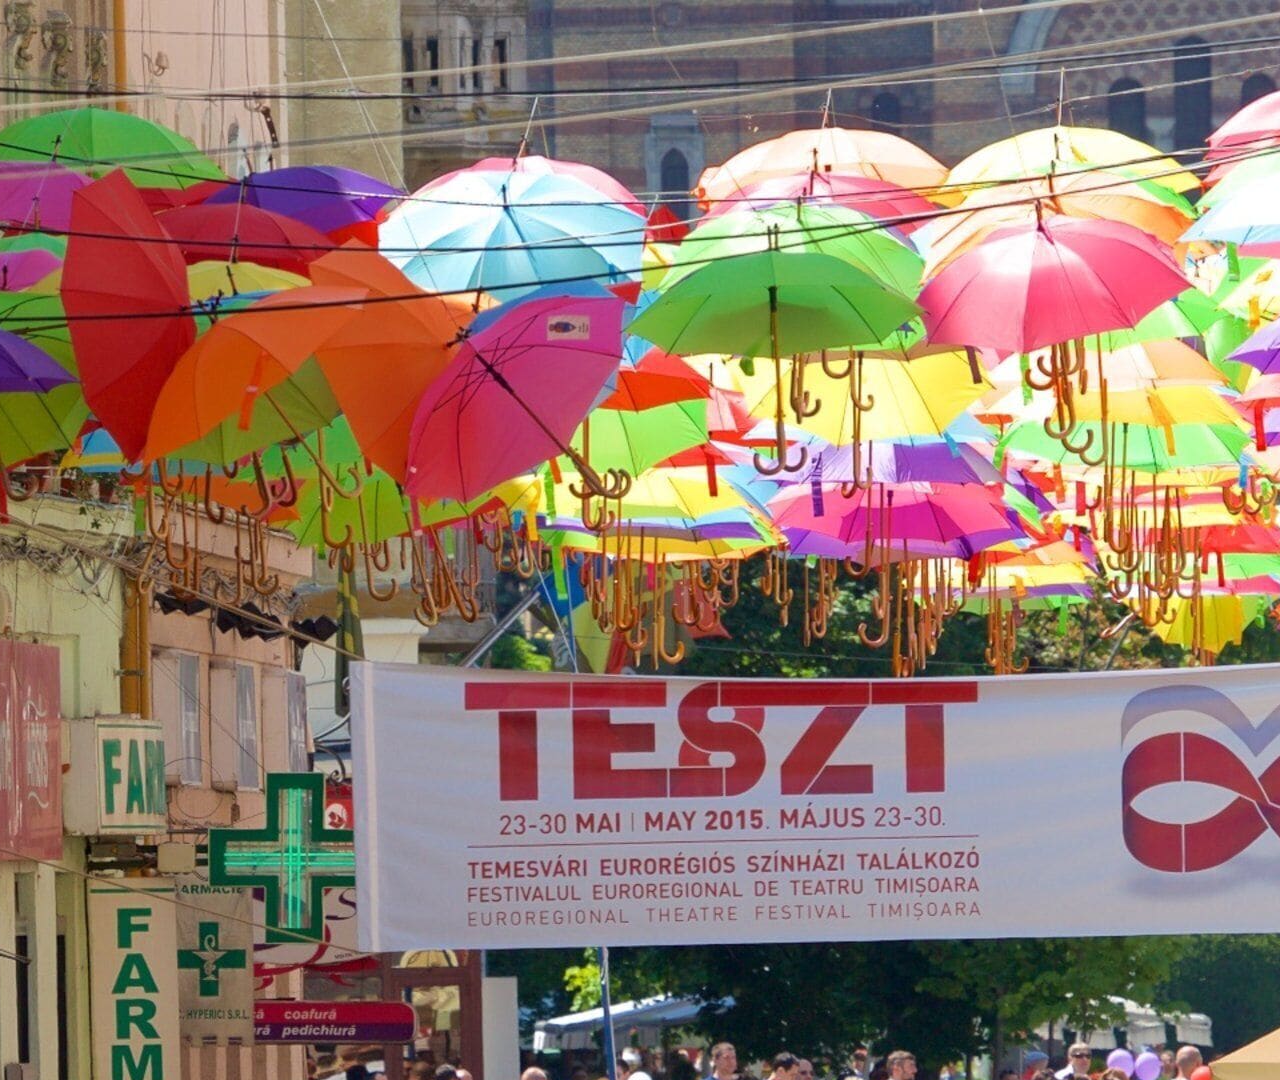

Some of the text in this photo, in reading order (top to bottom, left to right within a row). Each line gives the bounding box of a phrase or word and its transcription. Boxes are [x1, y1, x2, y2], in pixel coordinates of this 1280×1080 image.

[464, 681, 979, 801] TESZT
[499, 802, 946, 836] 23-30 MAI MAY 2015. MÁJUS 23-30.
[467, 846, 980, 880] TEMESVÁRI EURORÉGIÓS SZÍNHÁZI TALÁLKOZÓ
[467, 876, 980, 903] FESTIVALUL EUROREGIONAL DE TEATRU TIMIȘOARA
[467, 908, 630, 927] EUROREGIONAL
[646, 905, 738, 923] THEATRE
[754, 904, 851, 921] FESTIVAL
